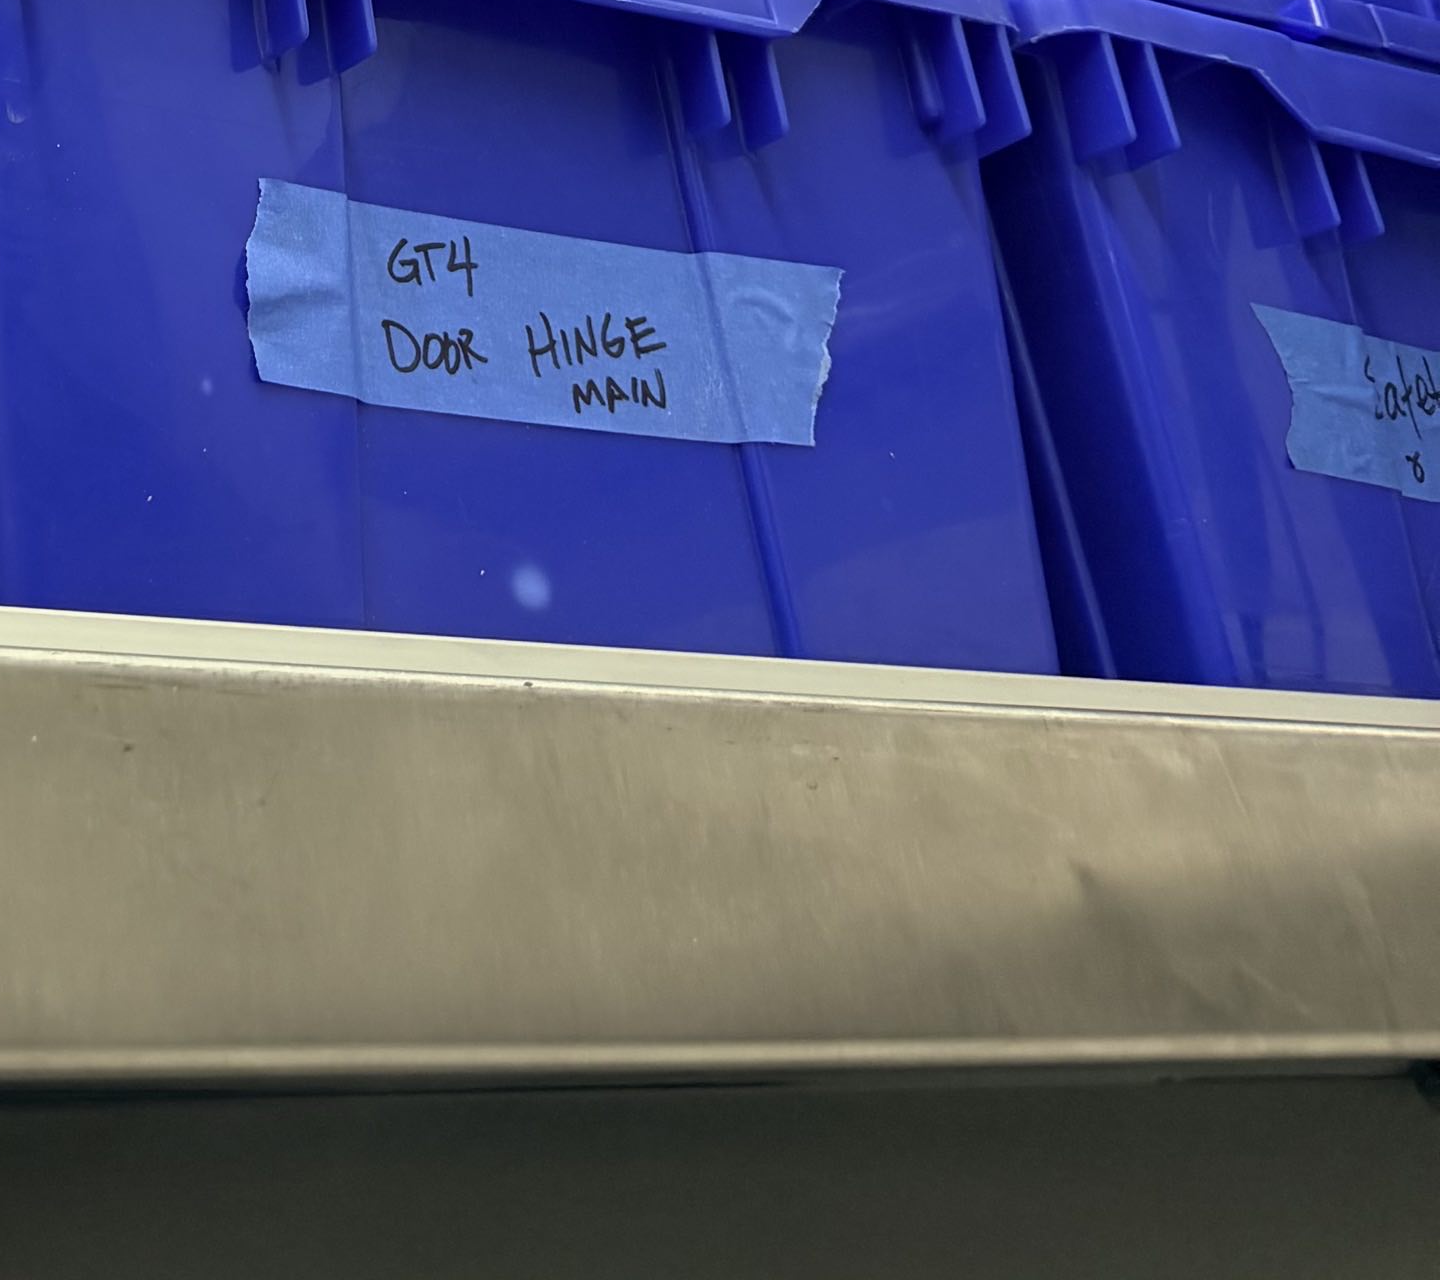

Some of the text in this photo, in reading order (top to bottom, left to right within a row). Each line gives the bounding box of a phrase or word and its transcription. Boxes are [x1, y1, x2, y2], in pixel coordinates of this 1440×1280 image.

[387, 235, 478, 297] GT4
[381, 311, 668, 378] DOOR HINGE
[572, 368, 667, 414] MAIN
